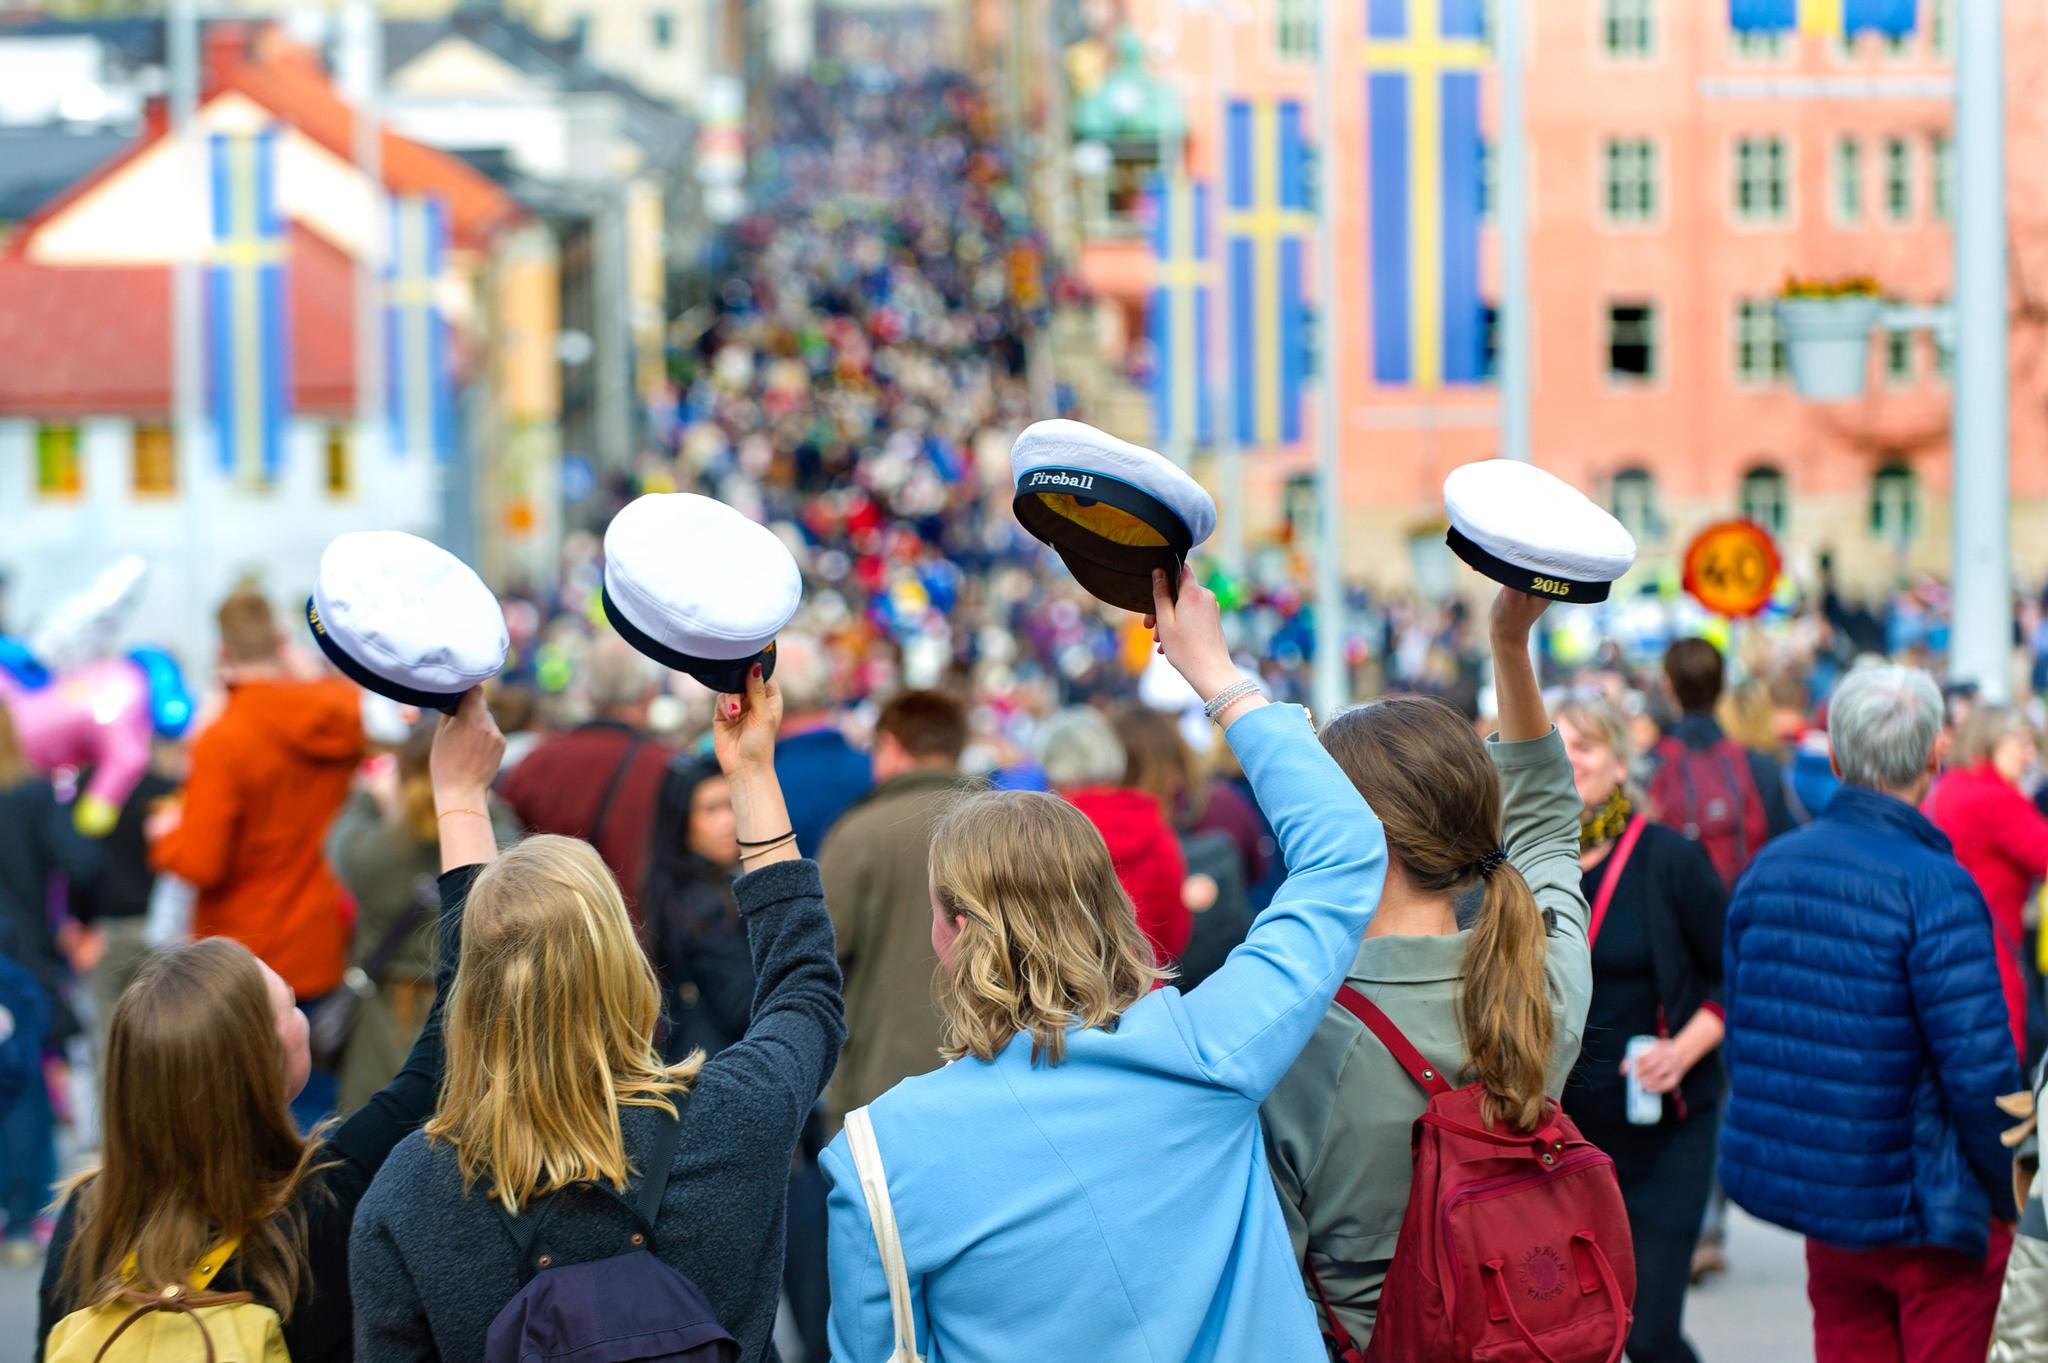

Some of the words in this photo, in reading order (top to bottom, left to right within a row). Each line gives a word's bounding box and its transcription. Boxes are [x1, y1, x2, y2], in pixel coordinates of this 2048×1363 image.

[1029, 472, 1093, 490] Fireball
[1698, 545, 1766, 590] 40
[1531, 578, 1570, 596] 2015
